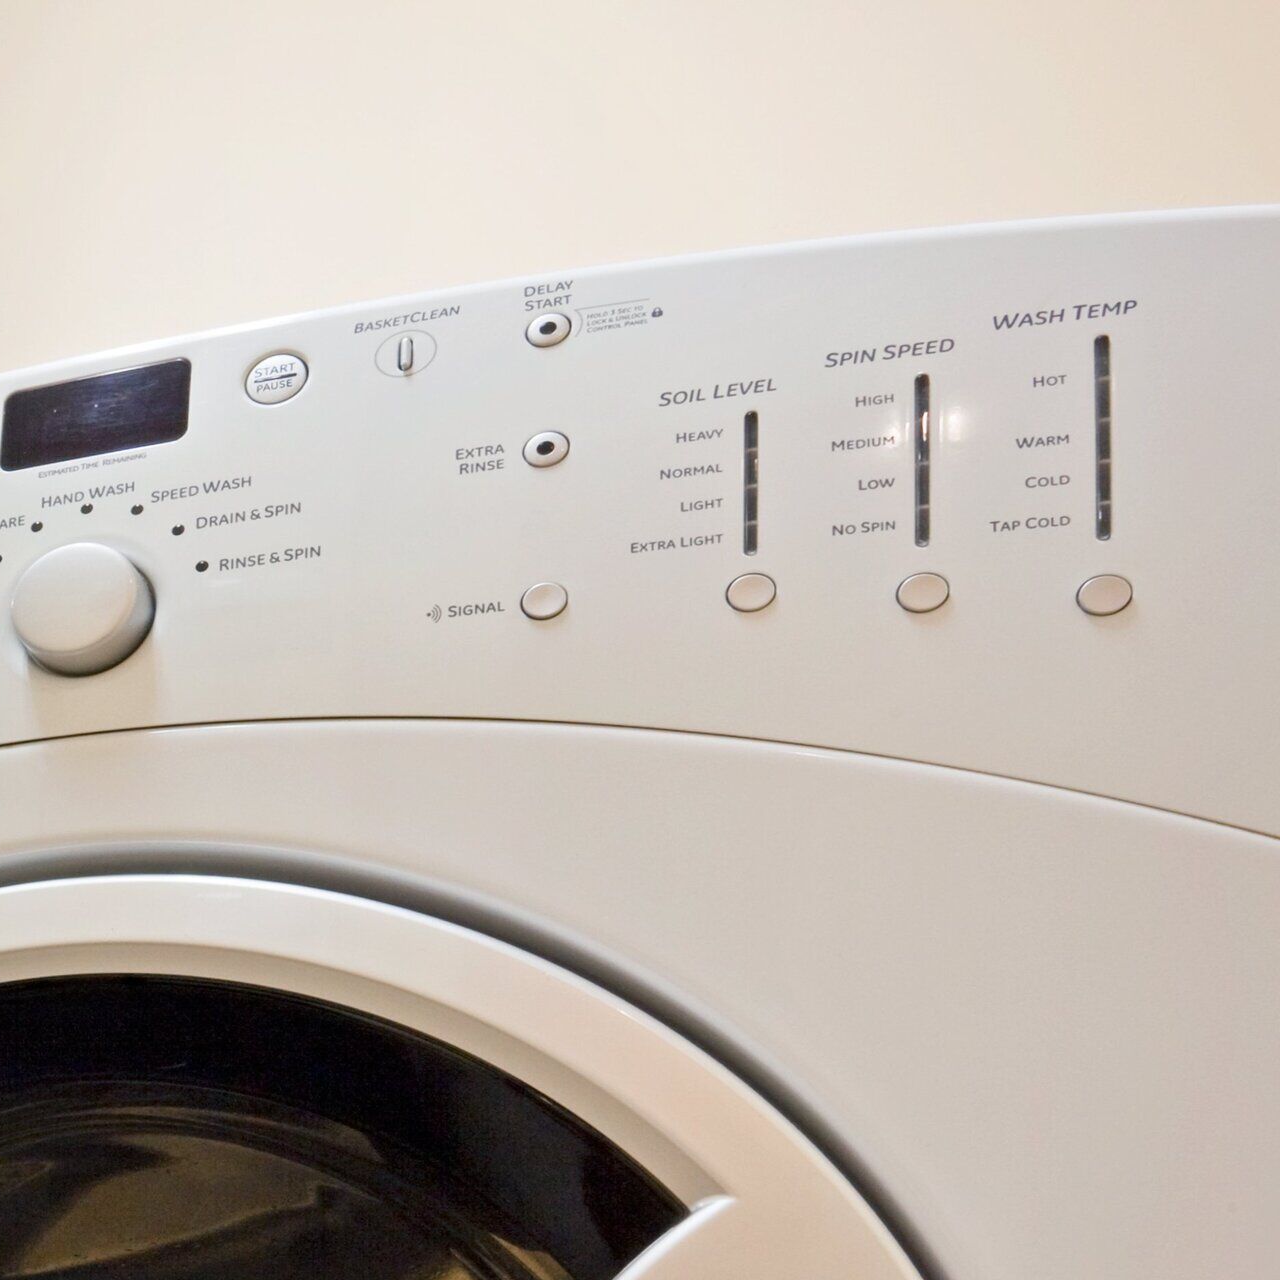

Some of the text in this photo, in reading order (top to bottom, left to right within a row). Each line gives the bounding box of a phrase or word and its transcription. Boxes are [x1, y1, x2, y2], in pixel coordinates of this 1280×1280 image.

[524, 280, 573, 297] DELAY
[525, 295, 572, 312] START
[354, 306, 460, 334] BASKETCLEAN
[993, 300, 1138, 330] WASH TEMP
[587, 323, 622, 334] CONTROL
[825, 338, 955, 368] SPIN SPEED
[255, 363, 296, 378] START
[257, 379, 293, 393] PAUSE
[1033, 375, 1067, 388] HOT
[659, 378, 777, 407] SOIL LEVEL
[855, 394, 895, 408] HIGH
[676, 429, 724, 443] HEAVY
[831, 436, 895, 452] MEDIUM
[1016, 435, 1070, 449] WARM
[456, 443, 505, 461] EXTRA
[459, 459, 505, 475] RINSE
[660, 464, 723, 480] NORMAL
[151, 476, 253, 503] SPEED WASH
[858, 478, 895, 491] LOW
[1025, 475, 1070, 489] COLD
[41, 482, 135, 509] HAND WASH
[680, 499, 724, 513] LIGHT
[196, 502, 302, 529] DRAIN & SPIN
[832, 521, 896, 536] NO SPIN
[990, 516, 1071, 533] TAP COLD
[630, 534, 724, 554] EXTRA LIGHT
[220, 546, 322, 571] RINSE & SPIN
[448, 601, 506, 618] SIGNAL
